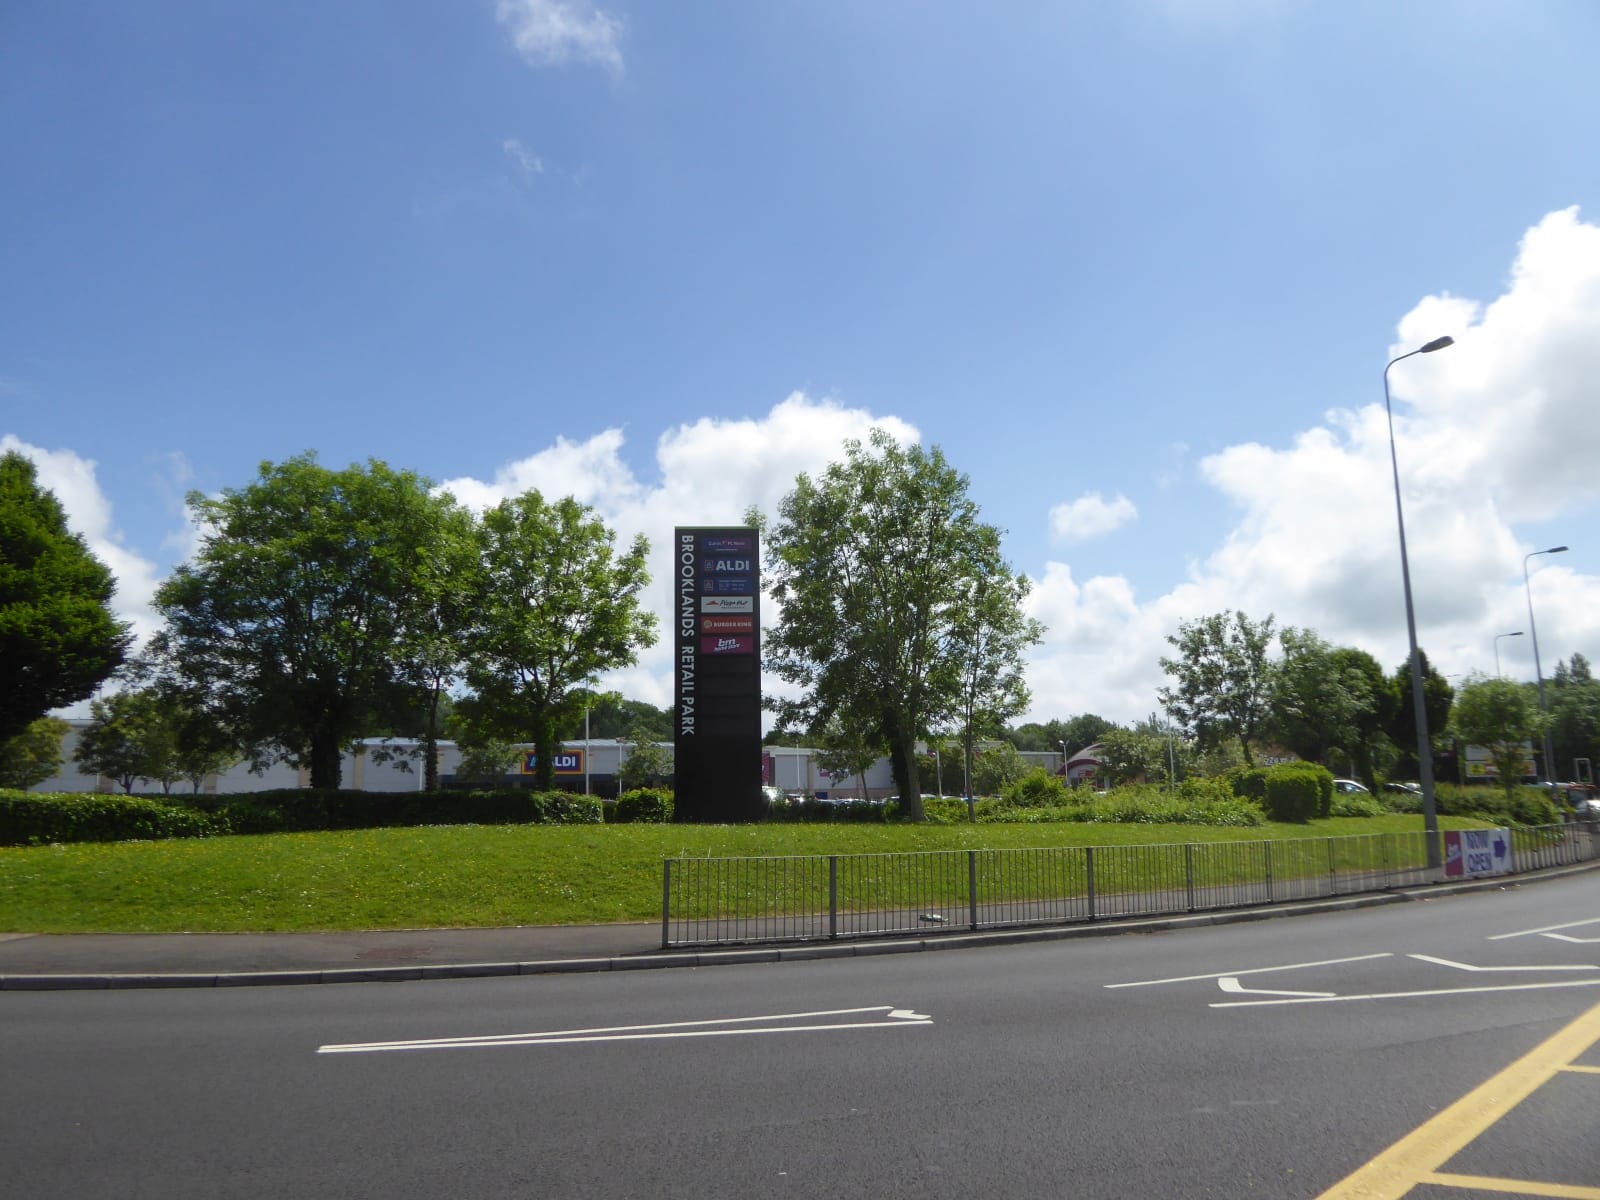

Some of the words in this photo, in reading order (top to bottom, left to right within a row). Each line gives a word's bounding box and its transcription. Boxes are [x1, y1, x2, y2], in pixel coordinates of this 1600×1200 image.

[715, 560, 750, 571] ALDI
[681, 535, 695, 637] BROOKLANDS
[681, 646, 695, 694] RETAIL
[681, 696, 695, 736] PARK
[552, 756, 576, 767] LDI
